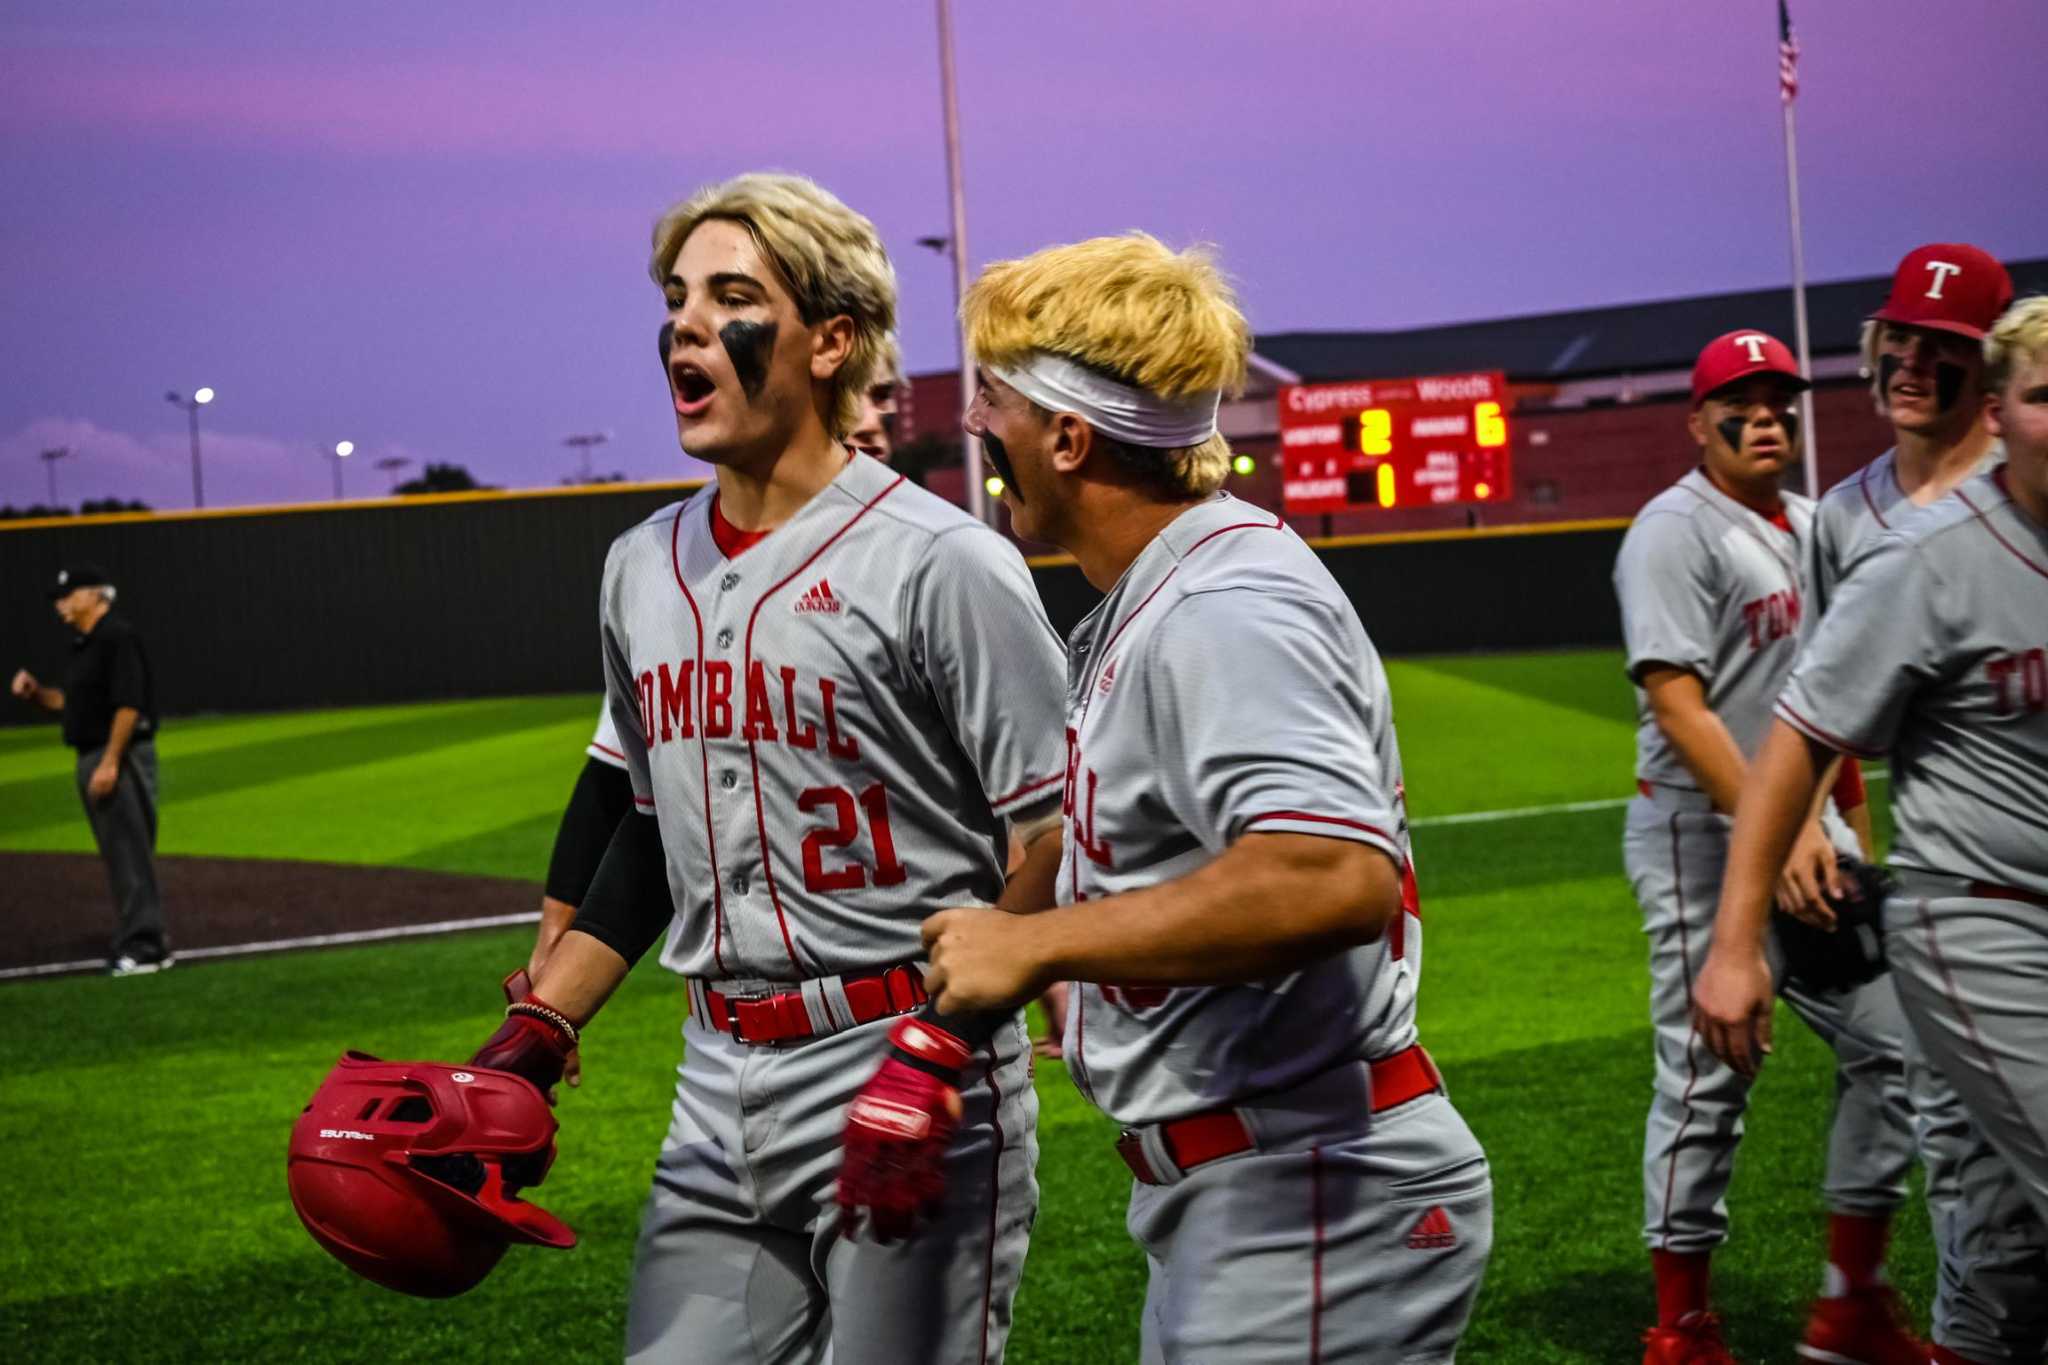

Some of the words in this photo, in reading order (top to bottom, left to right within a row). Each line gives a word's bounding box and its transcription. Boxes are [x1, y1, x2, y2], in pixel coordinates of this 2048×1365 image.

[1925, 260, 1962, 299] T
[1734, 335, 1767, 362] T
[1288, 386, 1372, 413] Cypress
[1417, 376, 1492, 401] Woods
[1475, 401, 1506, 447] 6
[1377, 463, 1396, 508] 1
[634, 659, 860, 762] OMBALL
[797, 783, 907, 893] 21
